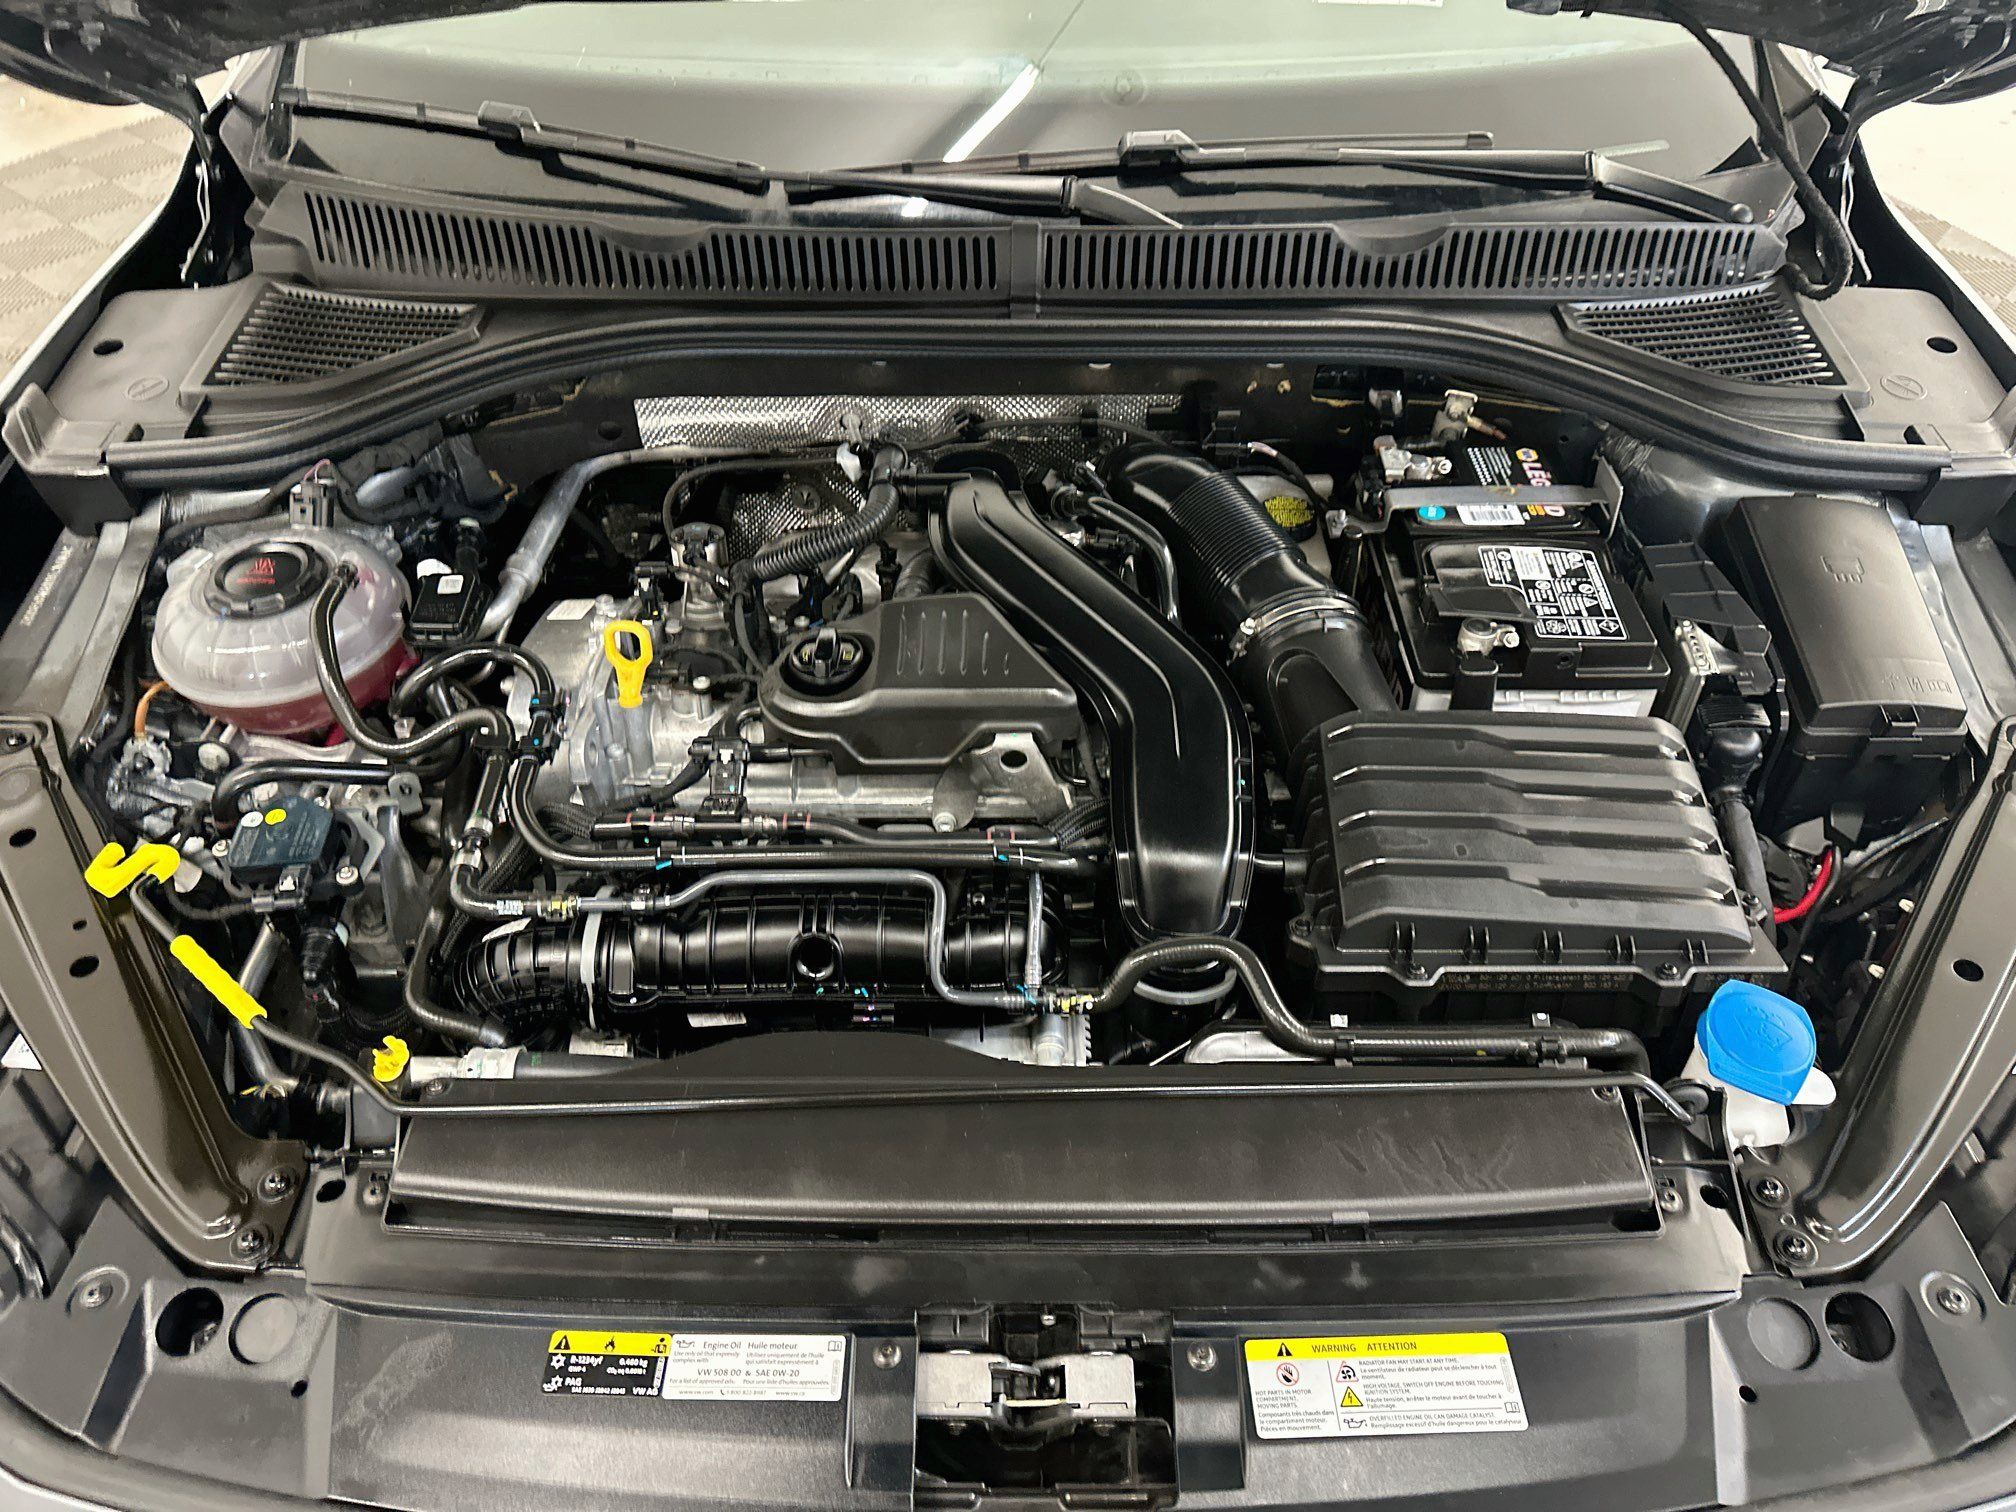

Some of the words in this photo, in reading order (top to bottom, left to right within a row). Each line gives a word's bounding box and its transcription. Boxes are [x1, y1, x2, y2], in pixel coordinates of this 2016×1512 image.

[704, 1342, 729, 1350] Engine
[1312, 1344, 1356, 1353] WARNING
[1367, 1342, 1417, 1351] ATTENTION
[570, 1355, 603, 1366] R-1234yf
[640, 1359, 648, 1368] kg
[565, 1377, 582, 1386] PAG
[632, 1387, 646, 1395] VW
[646, 1387, 658, 1396] AG
